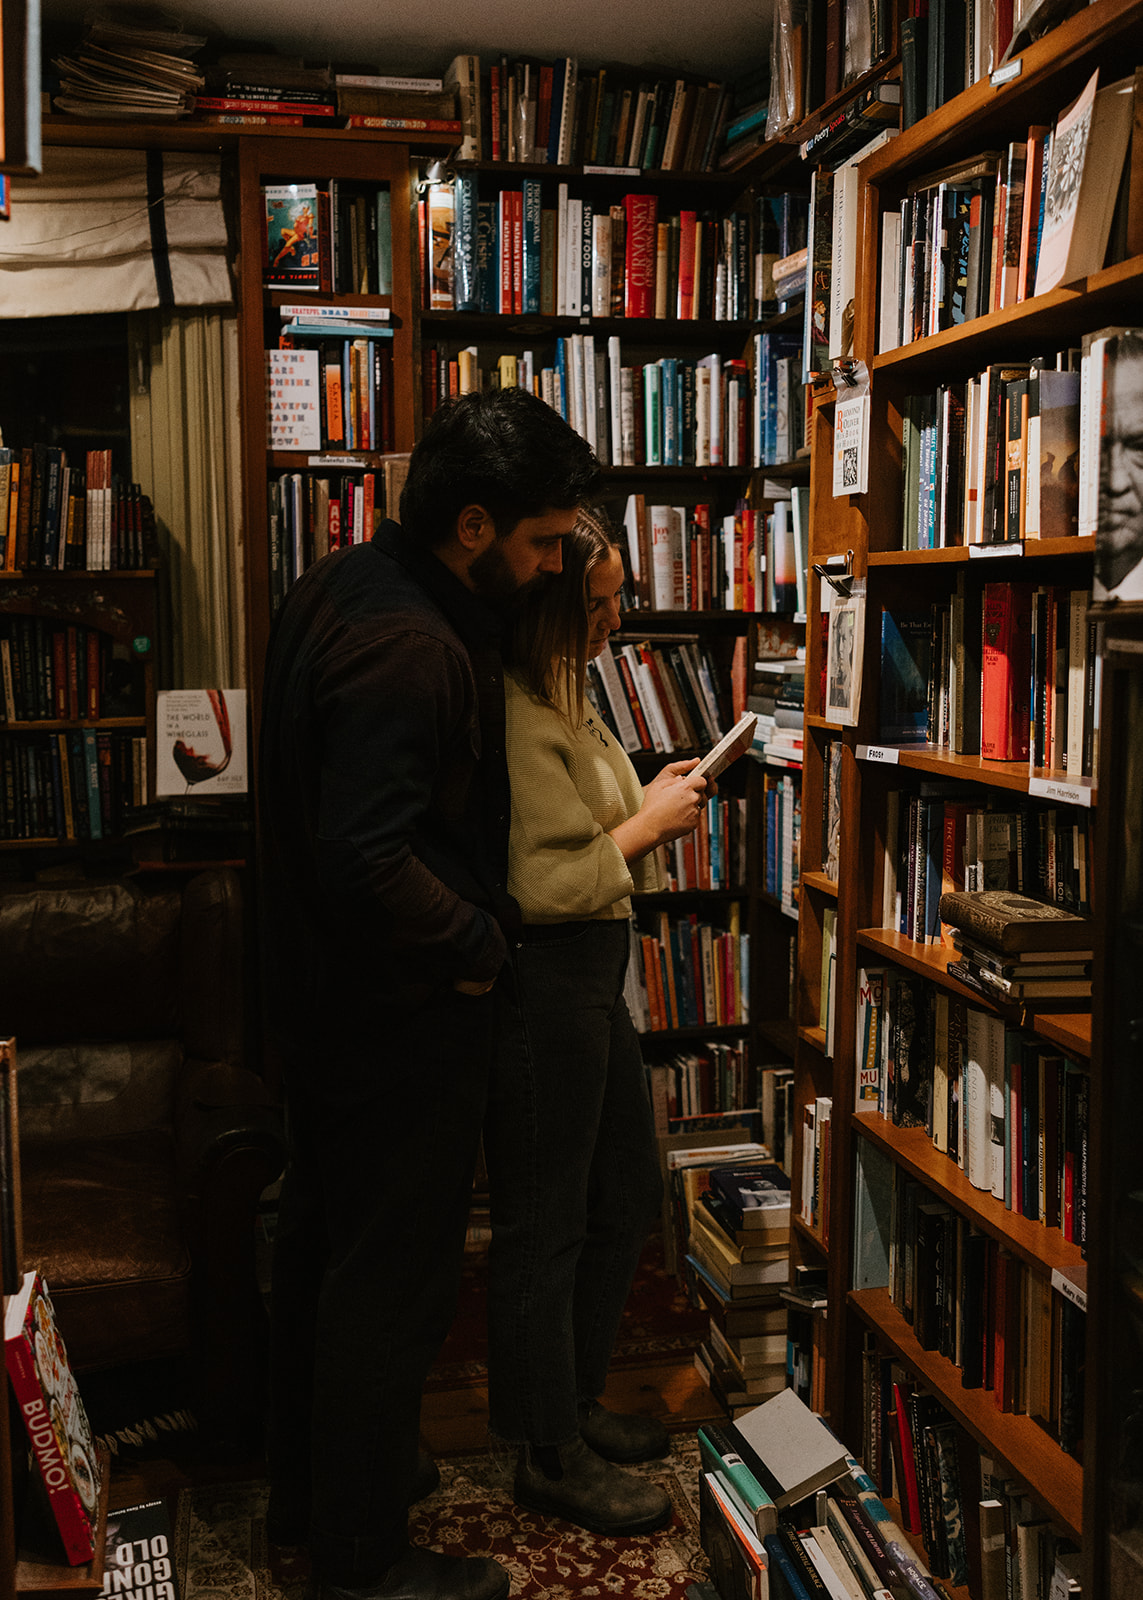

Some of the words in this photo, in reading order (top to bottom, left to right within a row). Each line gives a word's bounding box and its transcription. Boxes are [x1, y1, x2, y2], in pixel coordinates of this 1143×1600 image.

[462, 178, 471, 233] GOURMETS
[533, 183, 541, 245] PROFESSIONAL
[583, 205, 591, 237] SNOW
[583, 238, 591, 269] FOOD
[631, 199, 647, 287] CURNONSKY
[291, 308, 320, 316] GRATEFUL
[321, 309, 349, 317] DEAD
[684, 366, 692, 387] Rave
[684, 391, 692, 429] Reviews
[268, 438, 299, 446] HOWS
[673, 561, 684, 605] BIBLE
[166, 713, 179, 721] THE
[182, 713, 210, 721] WORLD
[166, 730, 209, 738] WINEGLASS
[1057, 787, 1079, 800] Harrison
[945, 844, 953, 873] ILIAD
[1080, 1198, 1087, 1207] IN
[1062, 1282, 1075, 1300] Mary
[22, 1398, 70, 1495] BUDMO!
[786, 1530, 798, 1541] THE
[863, 1530, 885, 1558] SHADOWS
[115, 1534, 168, 1566] OLD
[791, 1541, 812, 1566] ESSENTIAL
[806, 1566, 824, 1590] HORACE
[905, 1566, 927, 1590] HORACE
